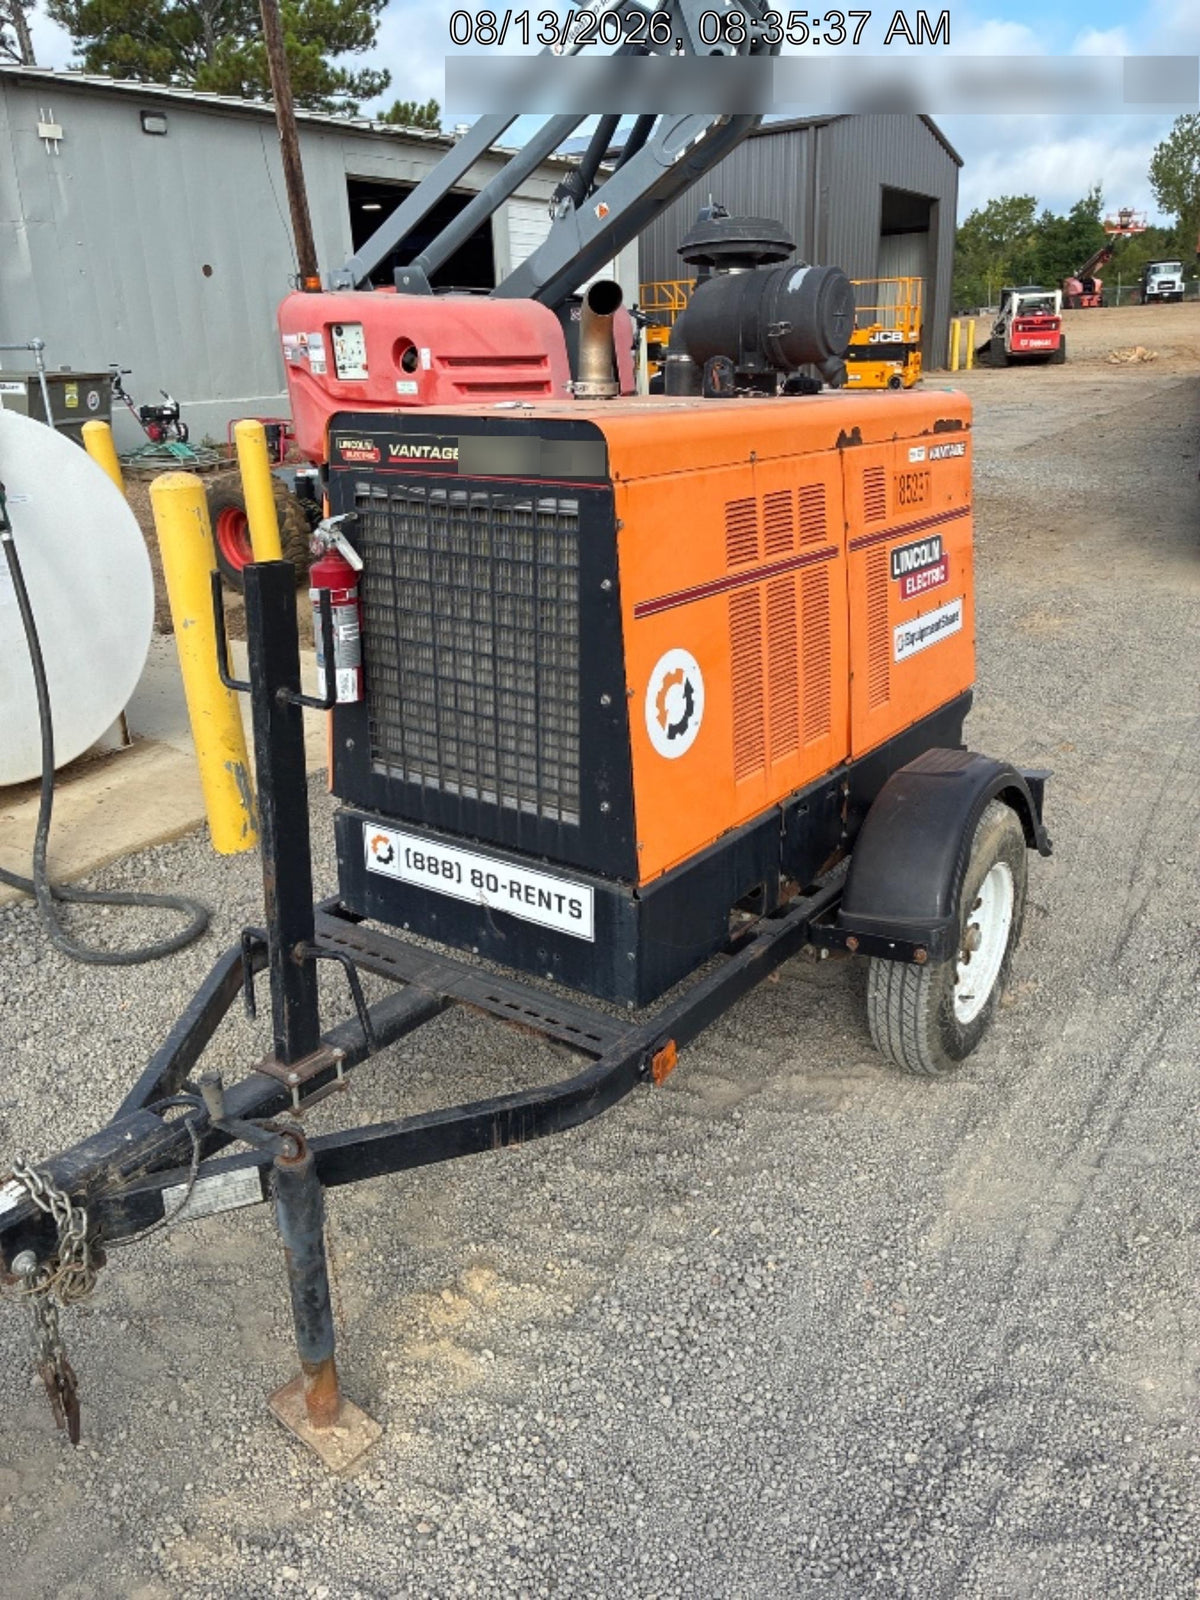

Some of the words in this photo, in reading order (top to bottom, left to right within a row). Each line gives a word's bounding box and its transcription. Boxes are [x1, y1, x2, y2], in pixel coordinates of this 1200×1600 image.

[869, 332, 903, 342] JCB
[893, 539, 941, 575] LINCOLN
[905, 564, 945, 595] ELECTRIC
[405, 847, 462, 884] (888)
[471, 868, 583, 920] 80-RENTS
